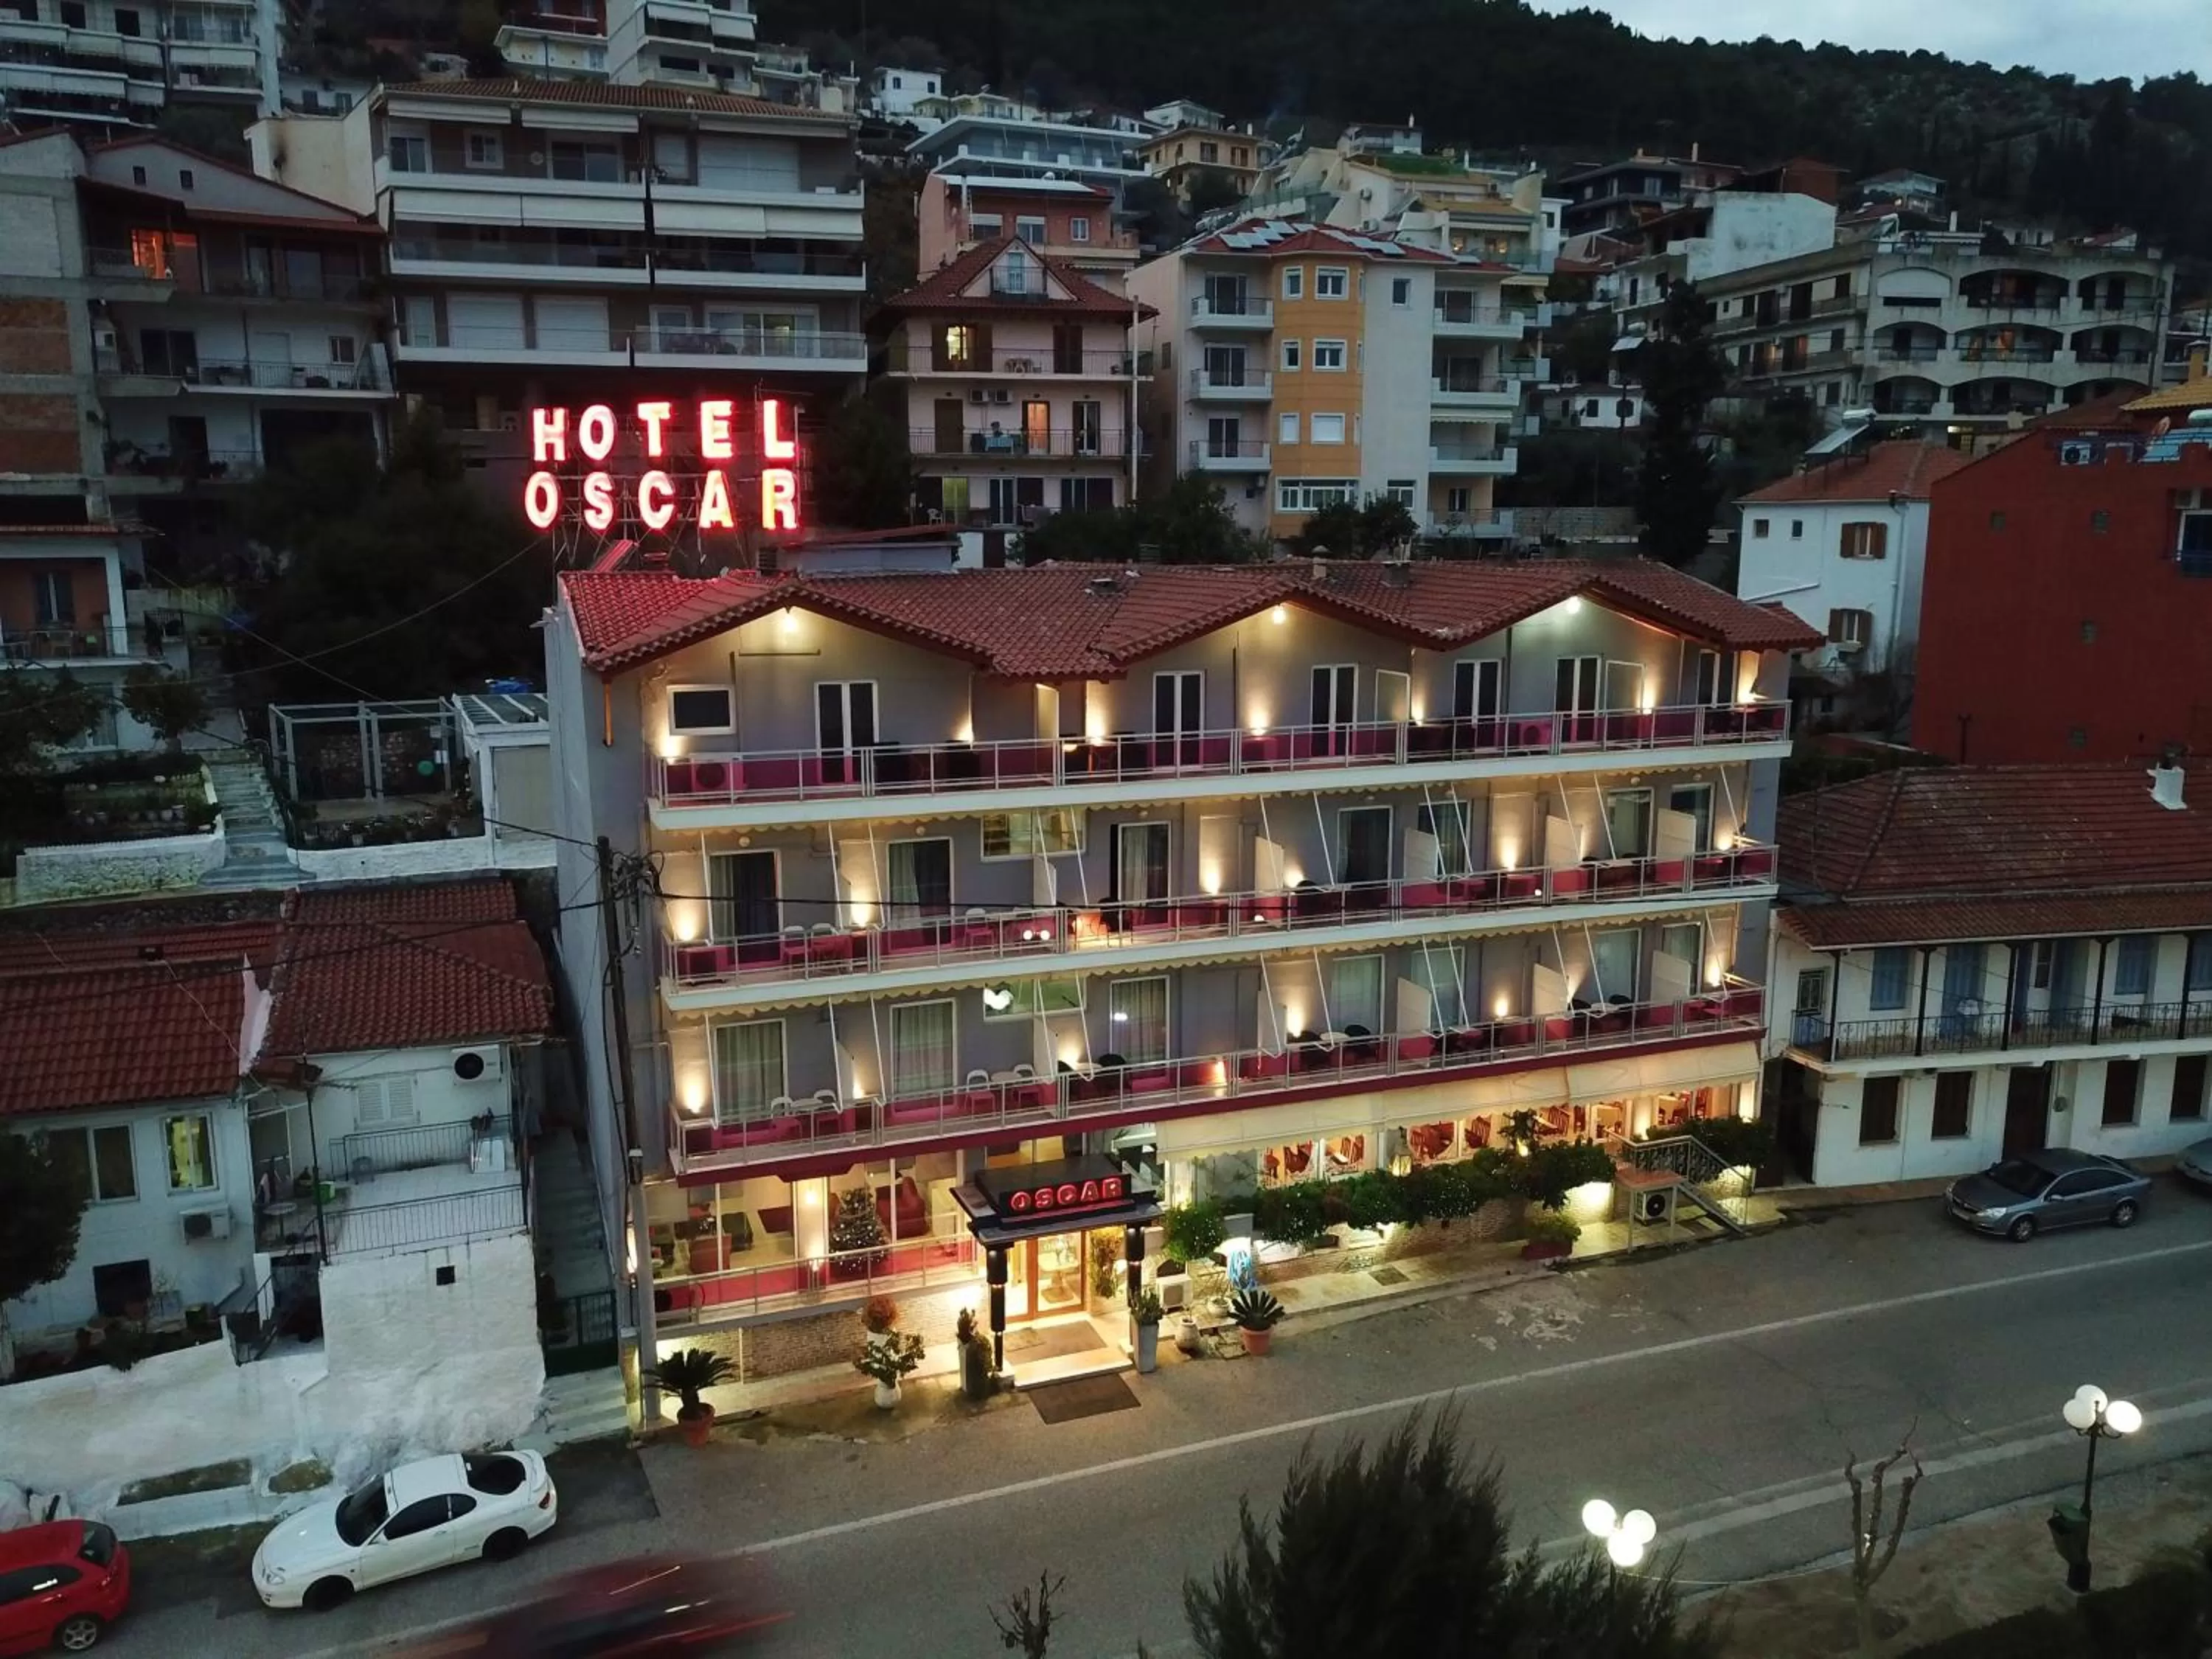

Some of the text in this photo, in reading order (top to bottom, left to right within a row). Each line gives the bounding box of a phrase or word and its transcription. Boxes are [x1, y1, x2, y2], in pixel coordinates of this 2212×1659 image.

[532, 400, 796, 462] HOTEL
[524, 469, 797, 529] OSCAR
[1010, 1178, 1123, 1211] OSCAR
